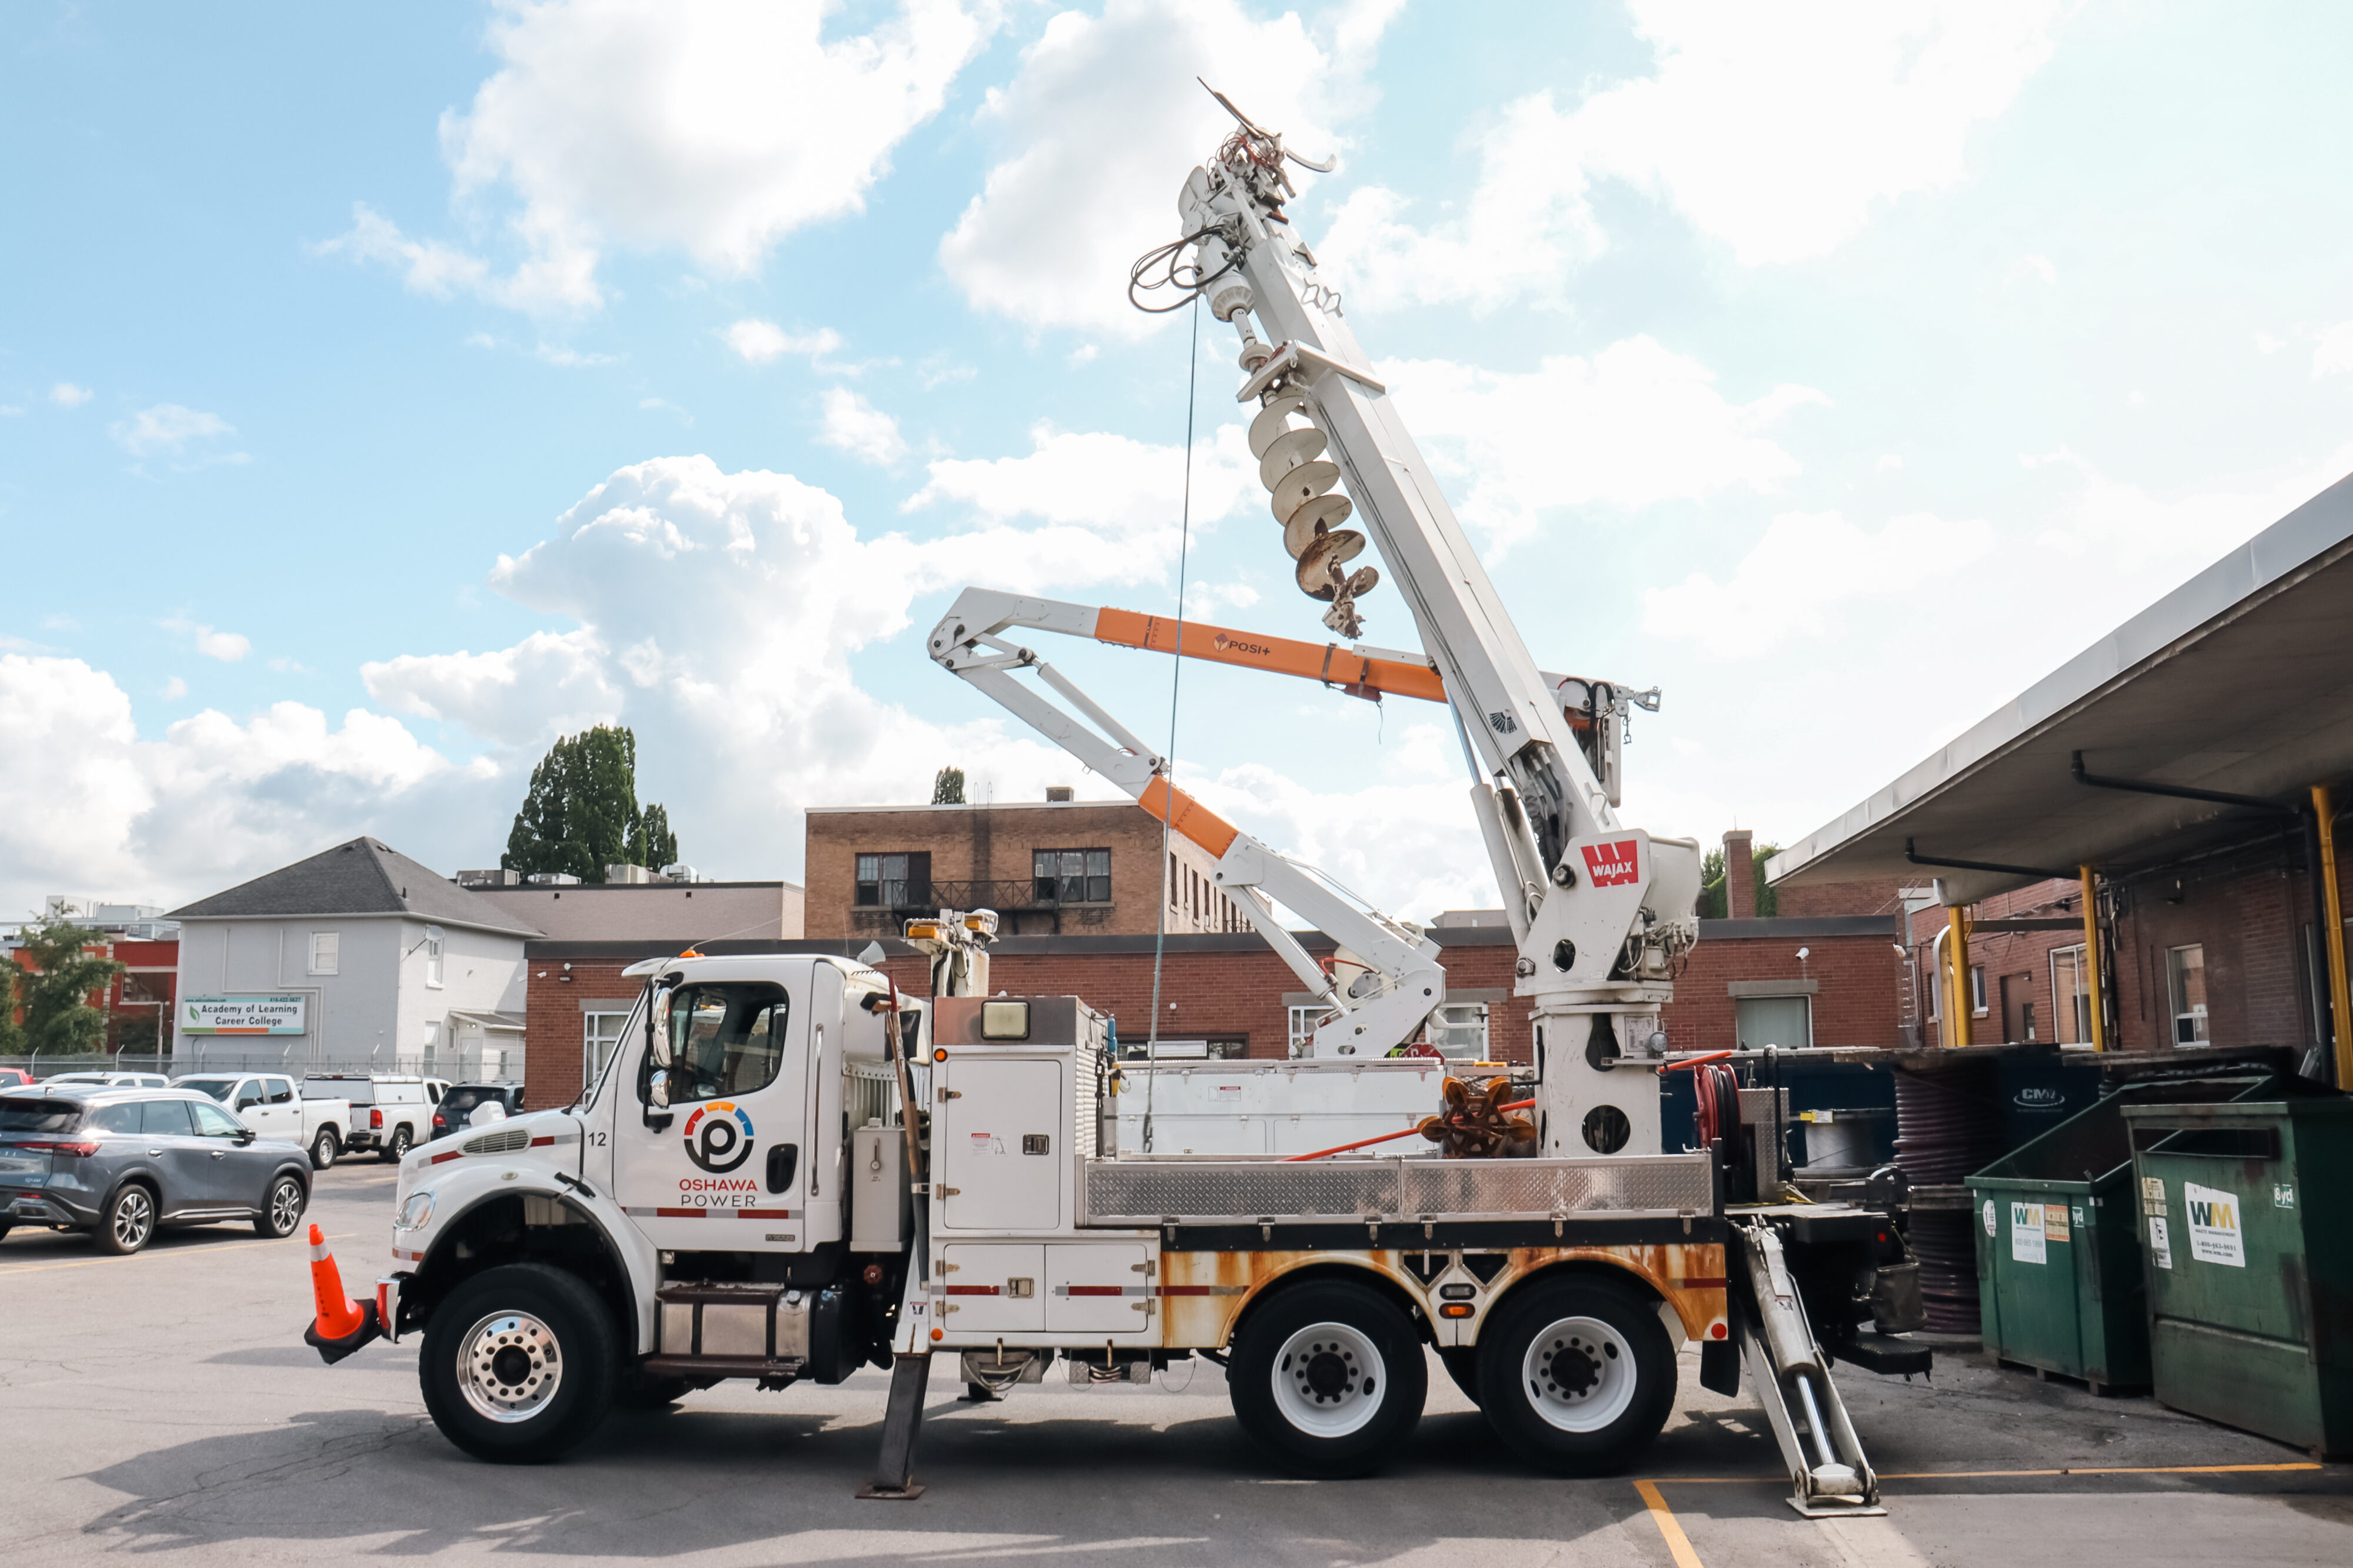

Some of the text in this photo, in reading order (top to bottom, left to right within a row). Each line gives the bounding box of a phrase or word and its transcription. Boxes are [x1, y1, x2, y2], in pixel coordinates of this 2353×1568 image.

[1229, 640, 1270, 655] POSI+
[1592, 861, 1632, 878] WAJAX
[202, 1004, 298, 1015] Academy of Learning
[215, 1016, 282, 1026] Career College
[588, 1132, 606, 1146] 12
[679, 1179, 758, 1192] OSHAWA
[681, 1195, 756, 1207] POWER
[2275, 1187, 2294, 1205] 8yd
[2014, 1207, 2041, 1226] WM
[2072, 1210, 2084, 1224] yd
[2189, 1200, 2235, 1229] WM
